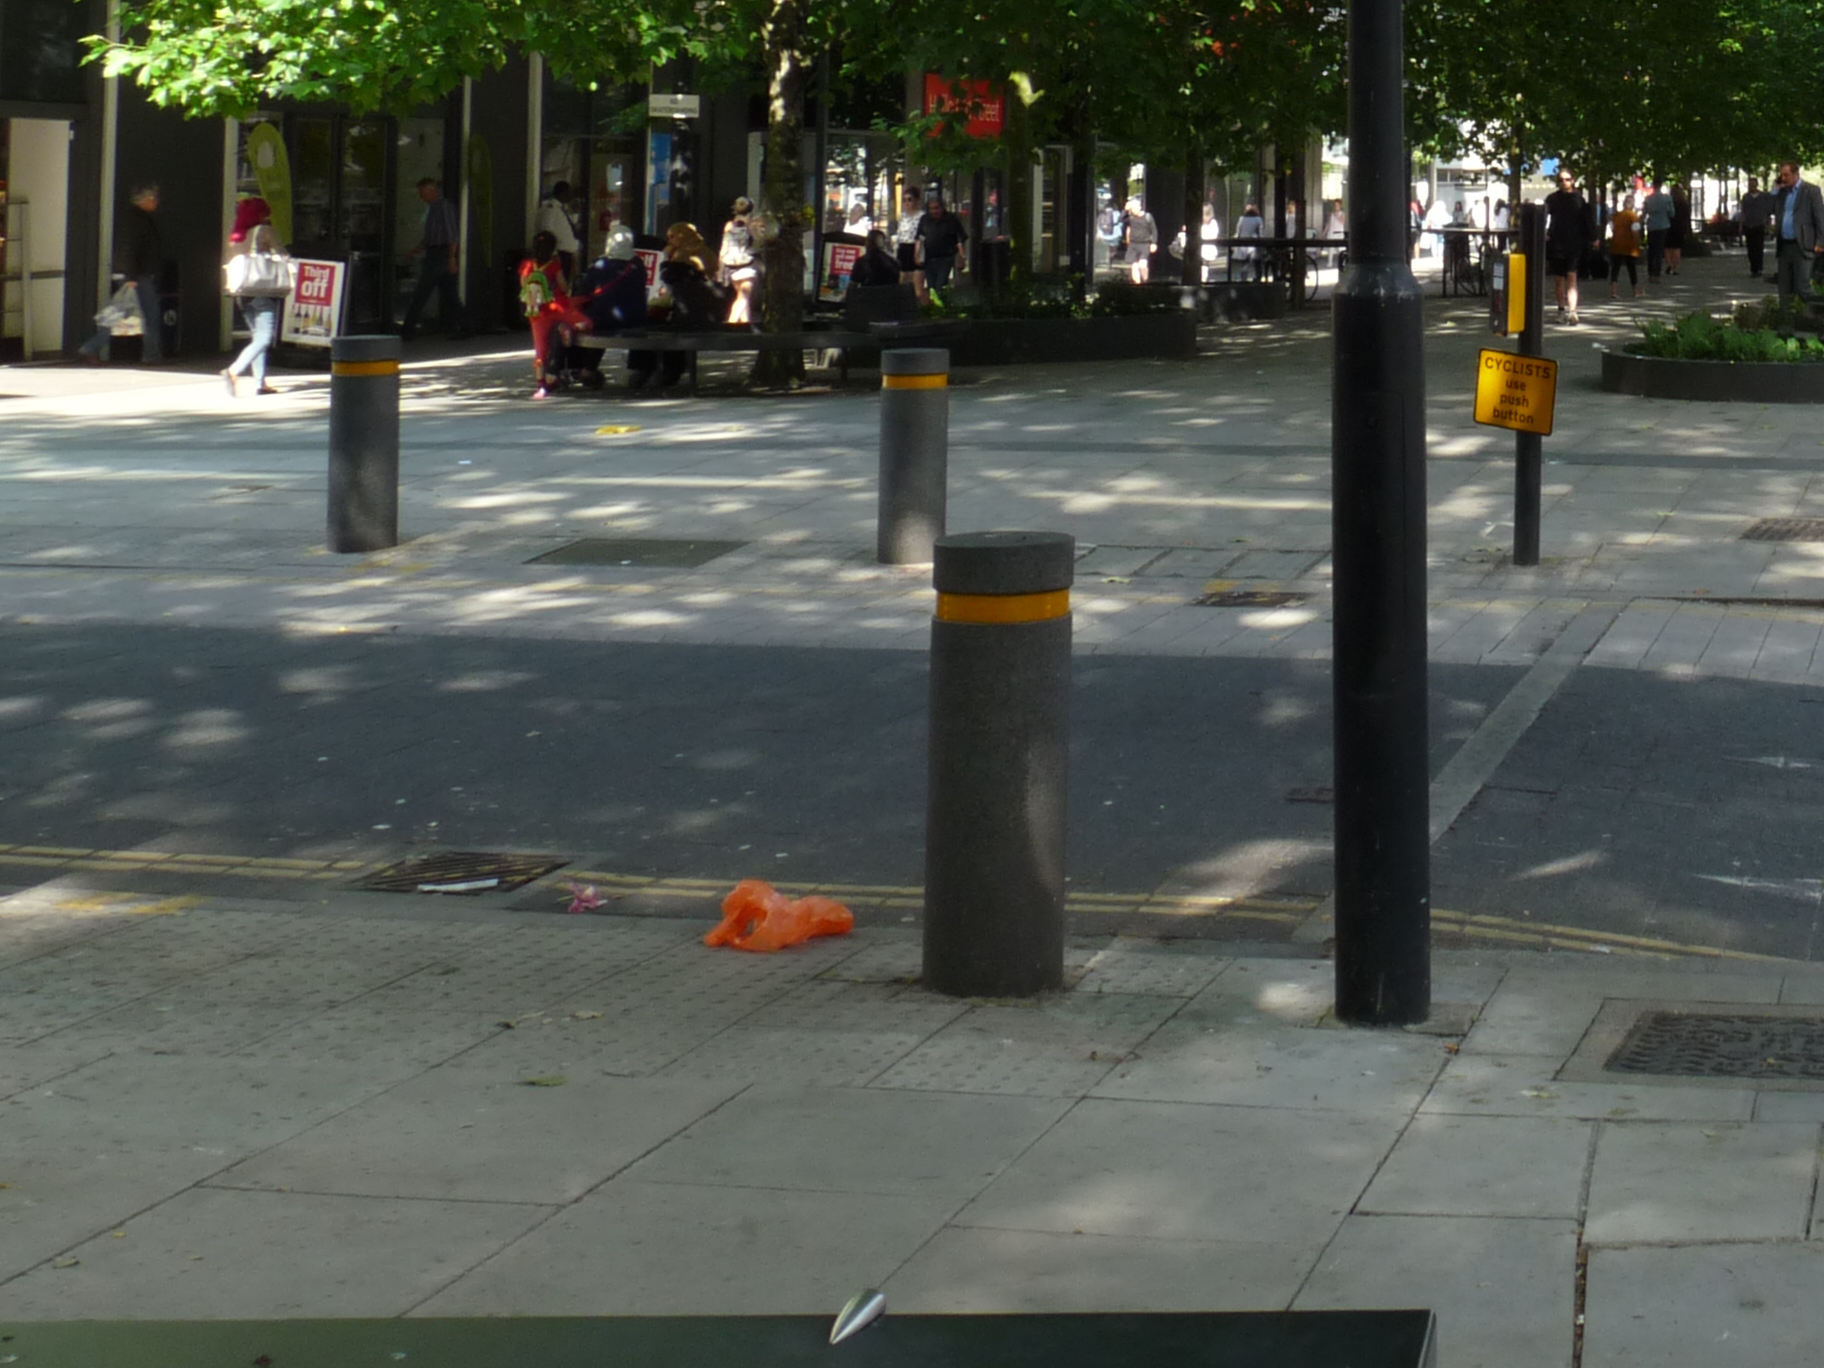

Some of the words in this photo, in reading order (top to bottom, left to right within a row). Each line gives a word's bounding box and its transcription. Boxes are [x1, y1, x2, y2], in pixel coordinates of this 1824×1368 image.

[303, 265, 330, 283] Third
[300, 278, 328, 299] off
[1485, 357, 1551, 379] CYCLISTS
[1506, 379, 1526, 391] use
[1500, 394, 1529, 408] push
[1493, 406, 1534, 424] button
